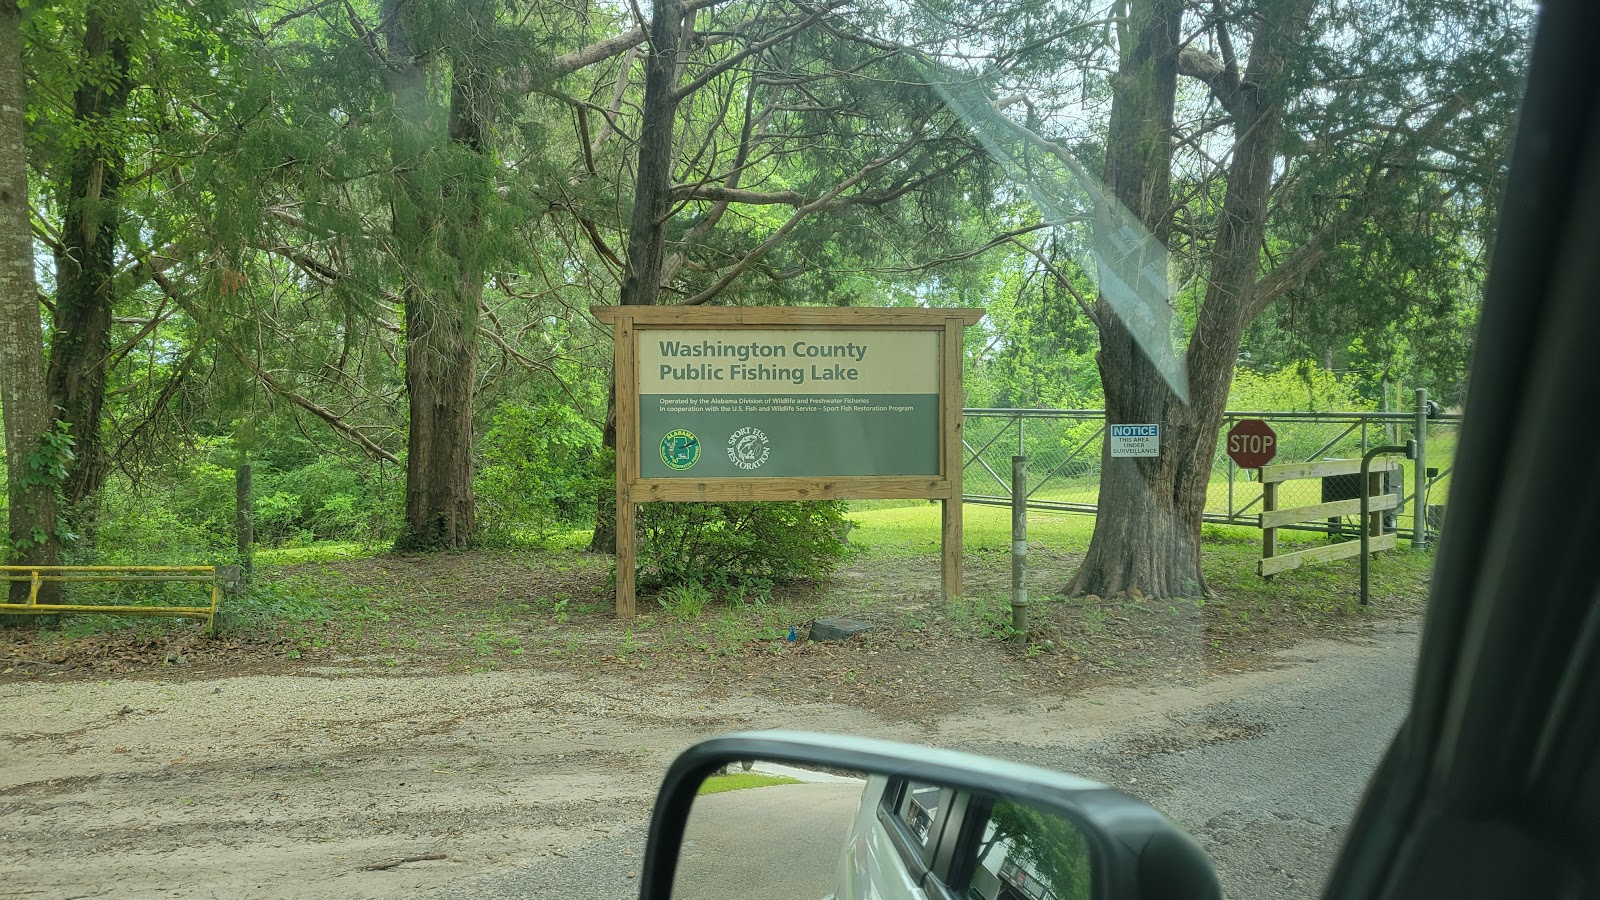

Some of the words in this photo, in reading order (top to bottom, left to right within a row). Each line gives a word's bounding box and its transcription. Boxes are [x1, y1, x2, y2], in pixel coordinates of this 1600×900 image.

[659, 340, 786, 361] Washington
[792, 341, 867, 361] County
[660, 363, 724, 380] Public
[730, 363, 804, 384] Fishing
[811, 363, 859, 380] Lake
[667, 430, 694, 441] ALABAMA
[728, 426, 752, 446] SPORT
[752, 428, 770, 445] FISH
[1113, 426, 1156, 436] NOTICE
[1230, 434, 1274, 454] STOP
[727, 446, 771, 470] RESTORATION
